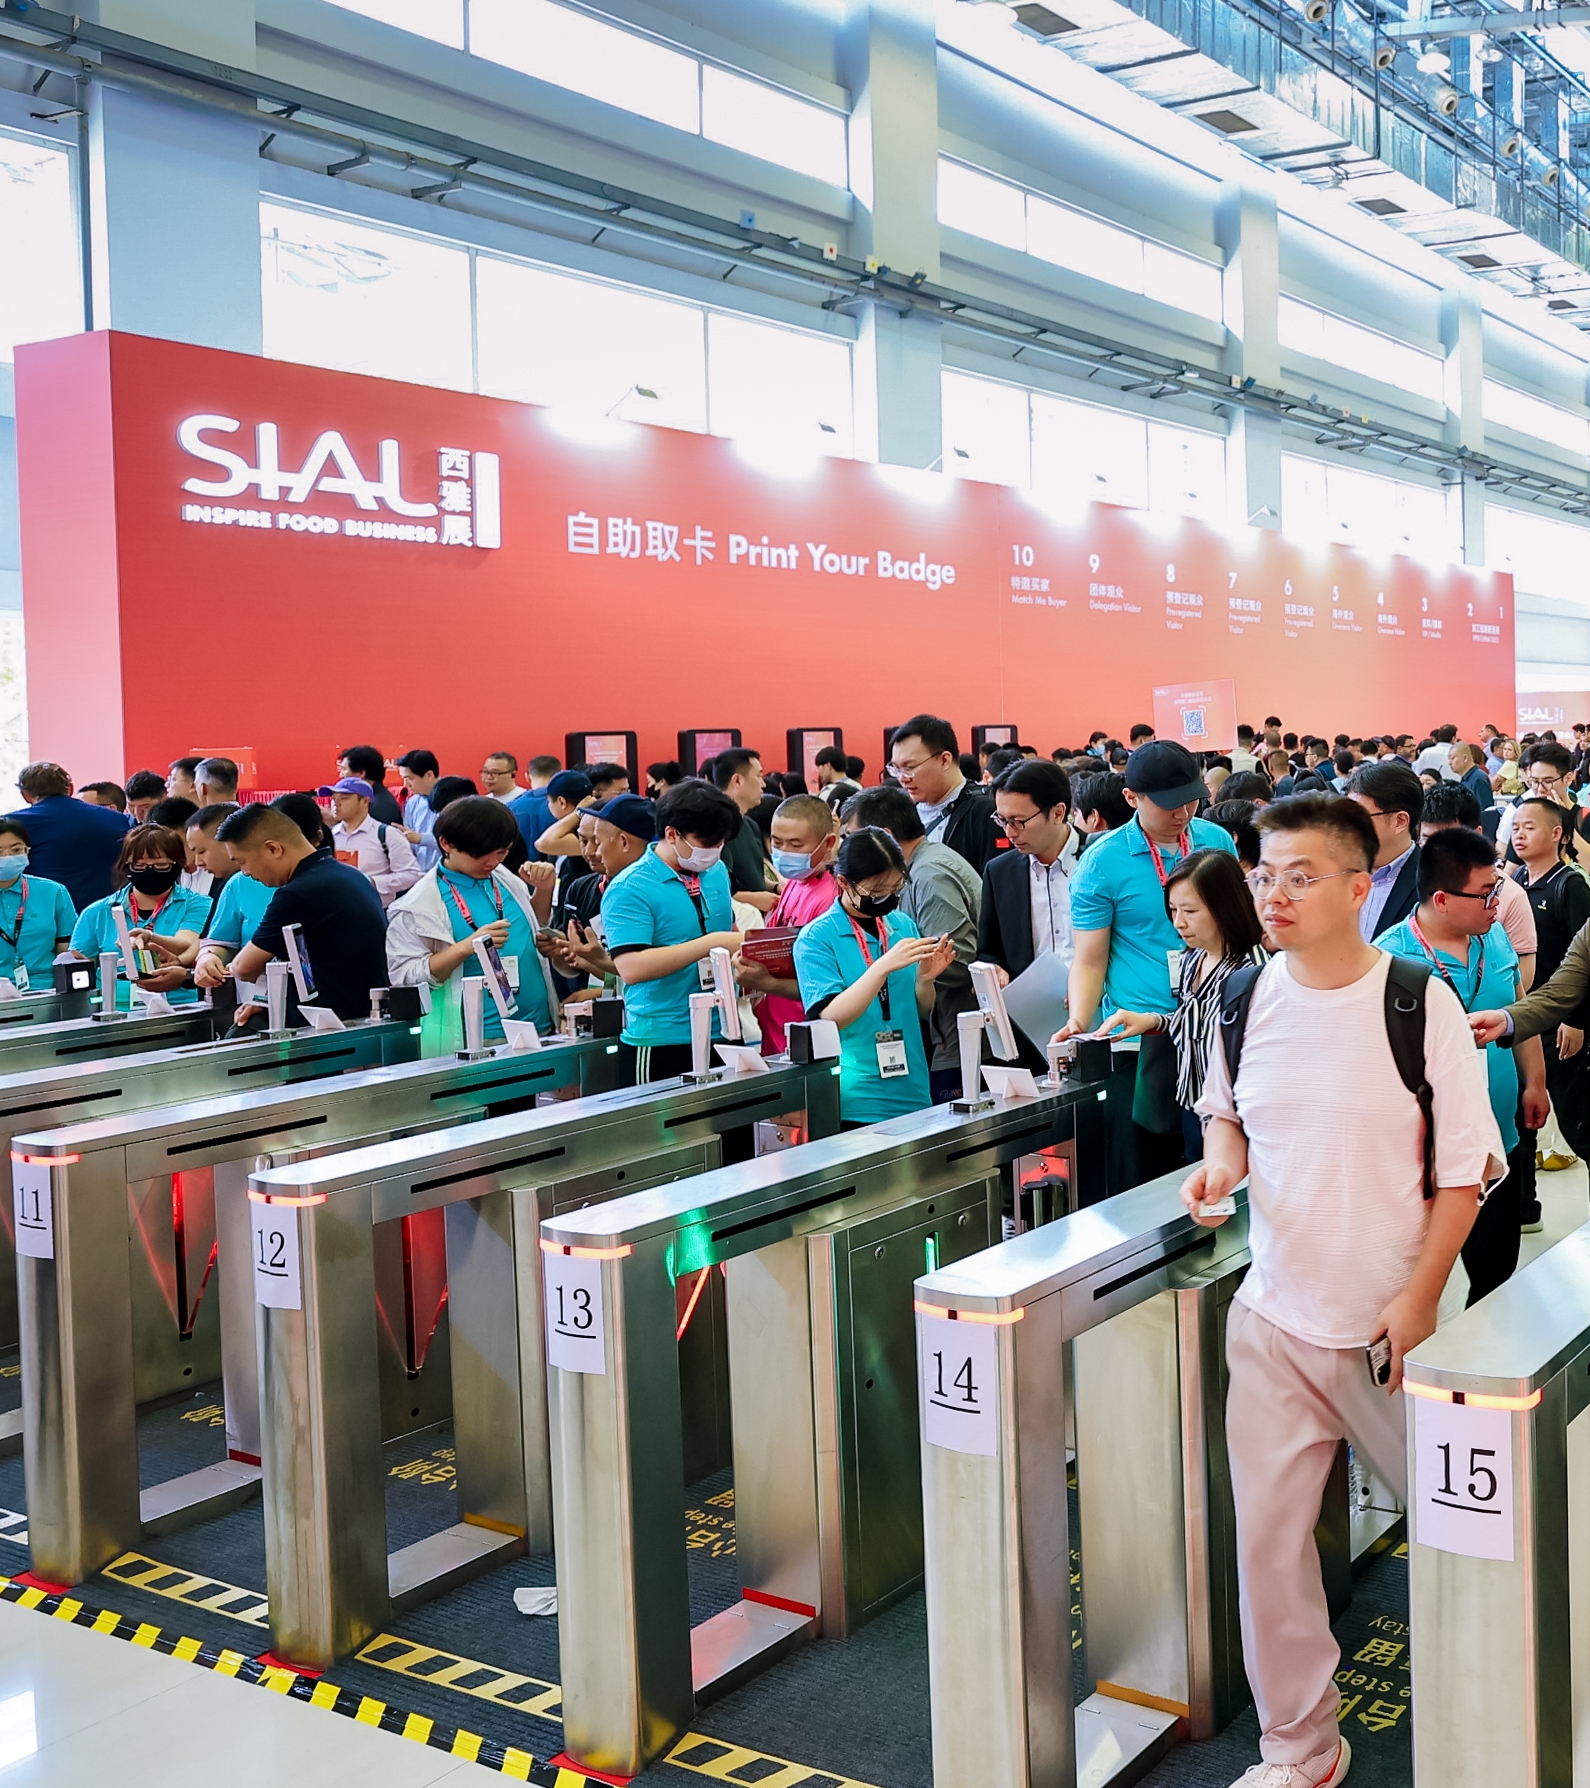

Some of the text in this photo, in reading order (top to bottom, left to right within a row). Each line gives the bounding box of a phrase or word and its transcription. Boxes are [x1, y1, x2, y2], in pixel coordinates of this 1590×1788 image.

[177, 413, 438, 517] SIAL
[437, 446, 472, 547] 西雅展
[181, 504, 438, 543] INSPIRE FOOD BUSINESS
[567, 511, 956, 591] 自助取卡 Print Your Badge
[1012, 545, 1034, 567] 10
[1089, 553, 1100, 573] 9
[1166, 563, 1176, 583] 8
[1089, 583, 1124, 598] 团体观众
[1228, 572, 1238, 589] 7
[1284, 579, 1293, 596] 6
[1011, 594, 1068, 609] Match Me Buyer
[1332, 585, 1340, 601] 5
[1377, 591, 1385, 606] 4
[1089, 599, 1142, 613] Delegation Visitor
[1421, 597, 1428, 612] 3
[1467, 602, 1474, 617] 2
[1499, 606, 1504, 619] 1
[1166, 620, 1183, 630] Visitor
[1518, 707, 1554, 720] SIAL
[19, 1187, 42, 1222] 11
[257, 1230, 287, 1269] 12
[555, 1286, 594, 1329] 13
[932, 1351, 979, 1403] 14
[1437, 1442, 1498, 1501] 15
[1334, 1669, 1394, 1692] step
